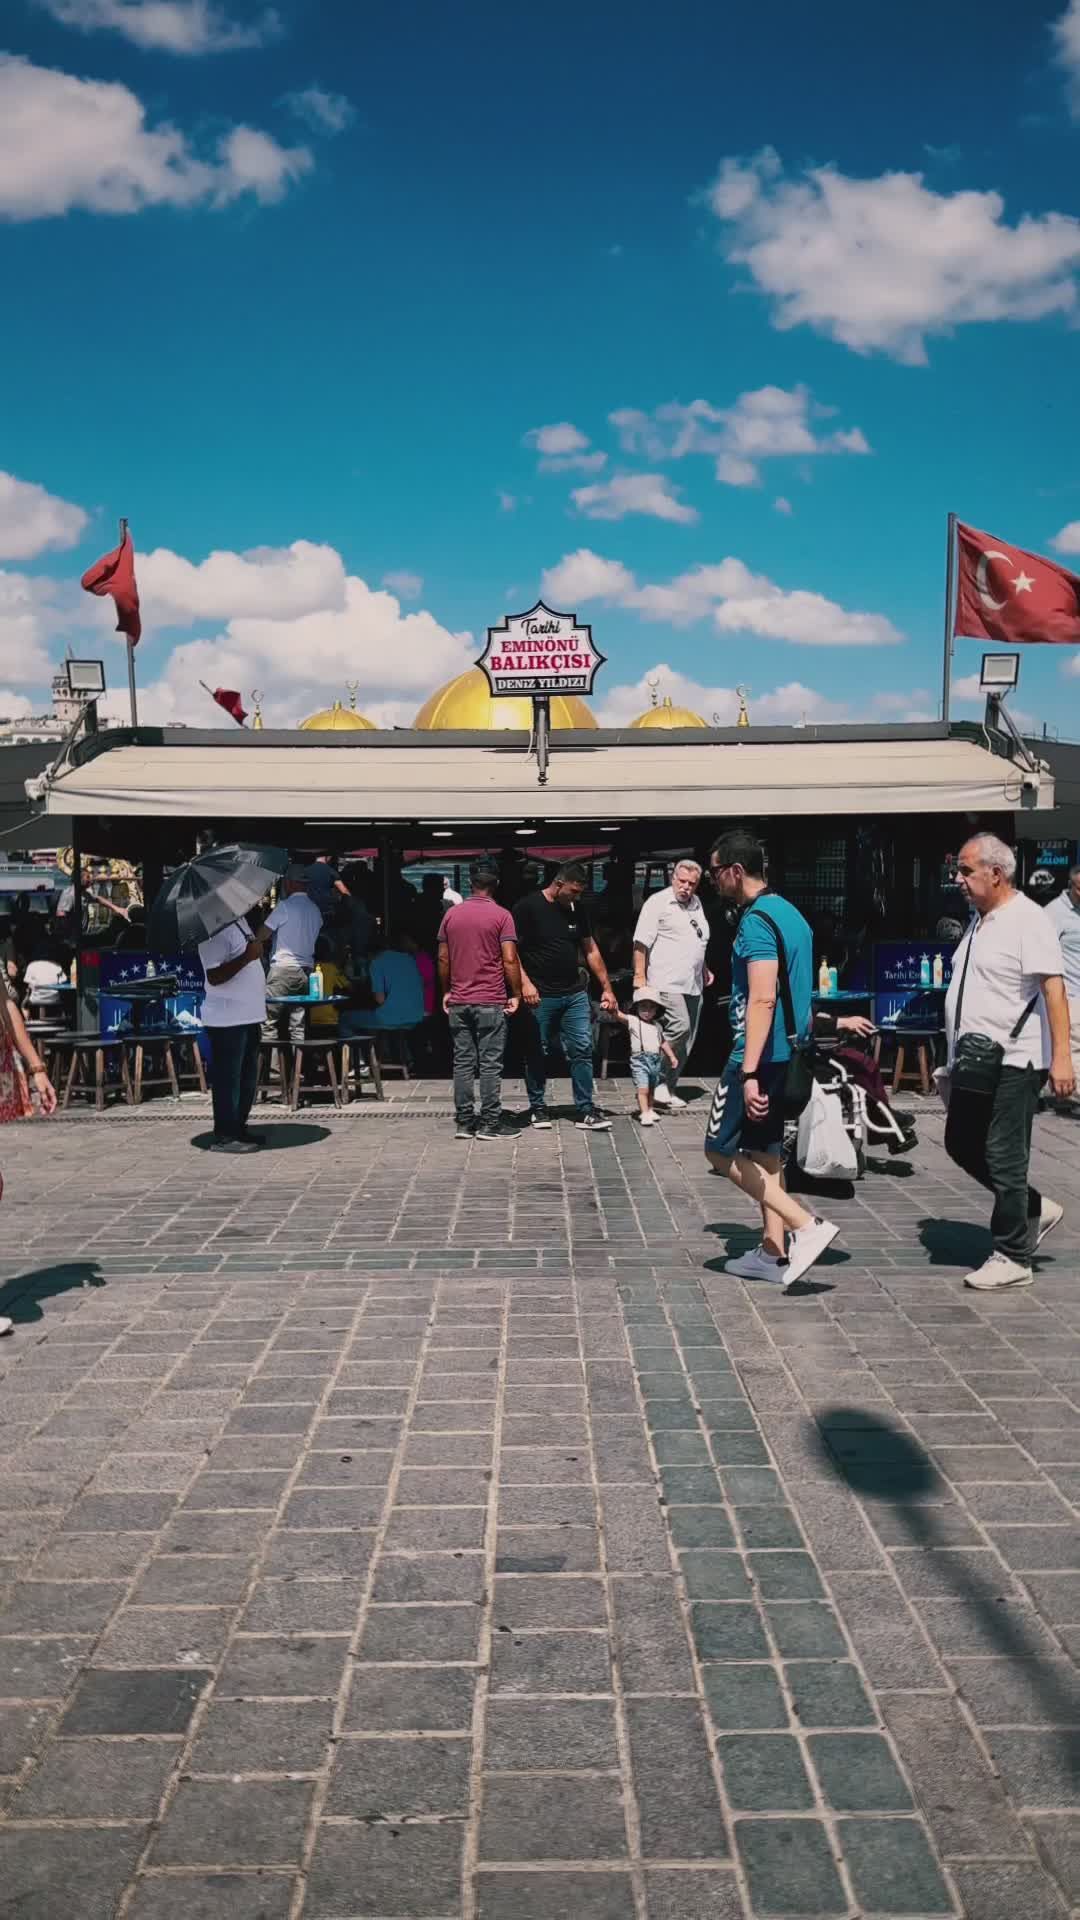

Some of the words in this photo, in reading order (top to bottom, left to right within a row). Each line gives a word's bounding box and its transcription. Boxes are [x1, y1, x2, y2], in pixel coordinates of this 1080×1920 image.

[521, 617, 561, 637] Tarihi
[501, 636, 579, 653] EMİNÖNÜ
[490, 654, 592, 673] BALIKÇISI
[537, 677, 585, 688] YILDIZI
